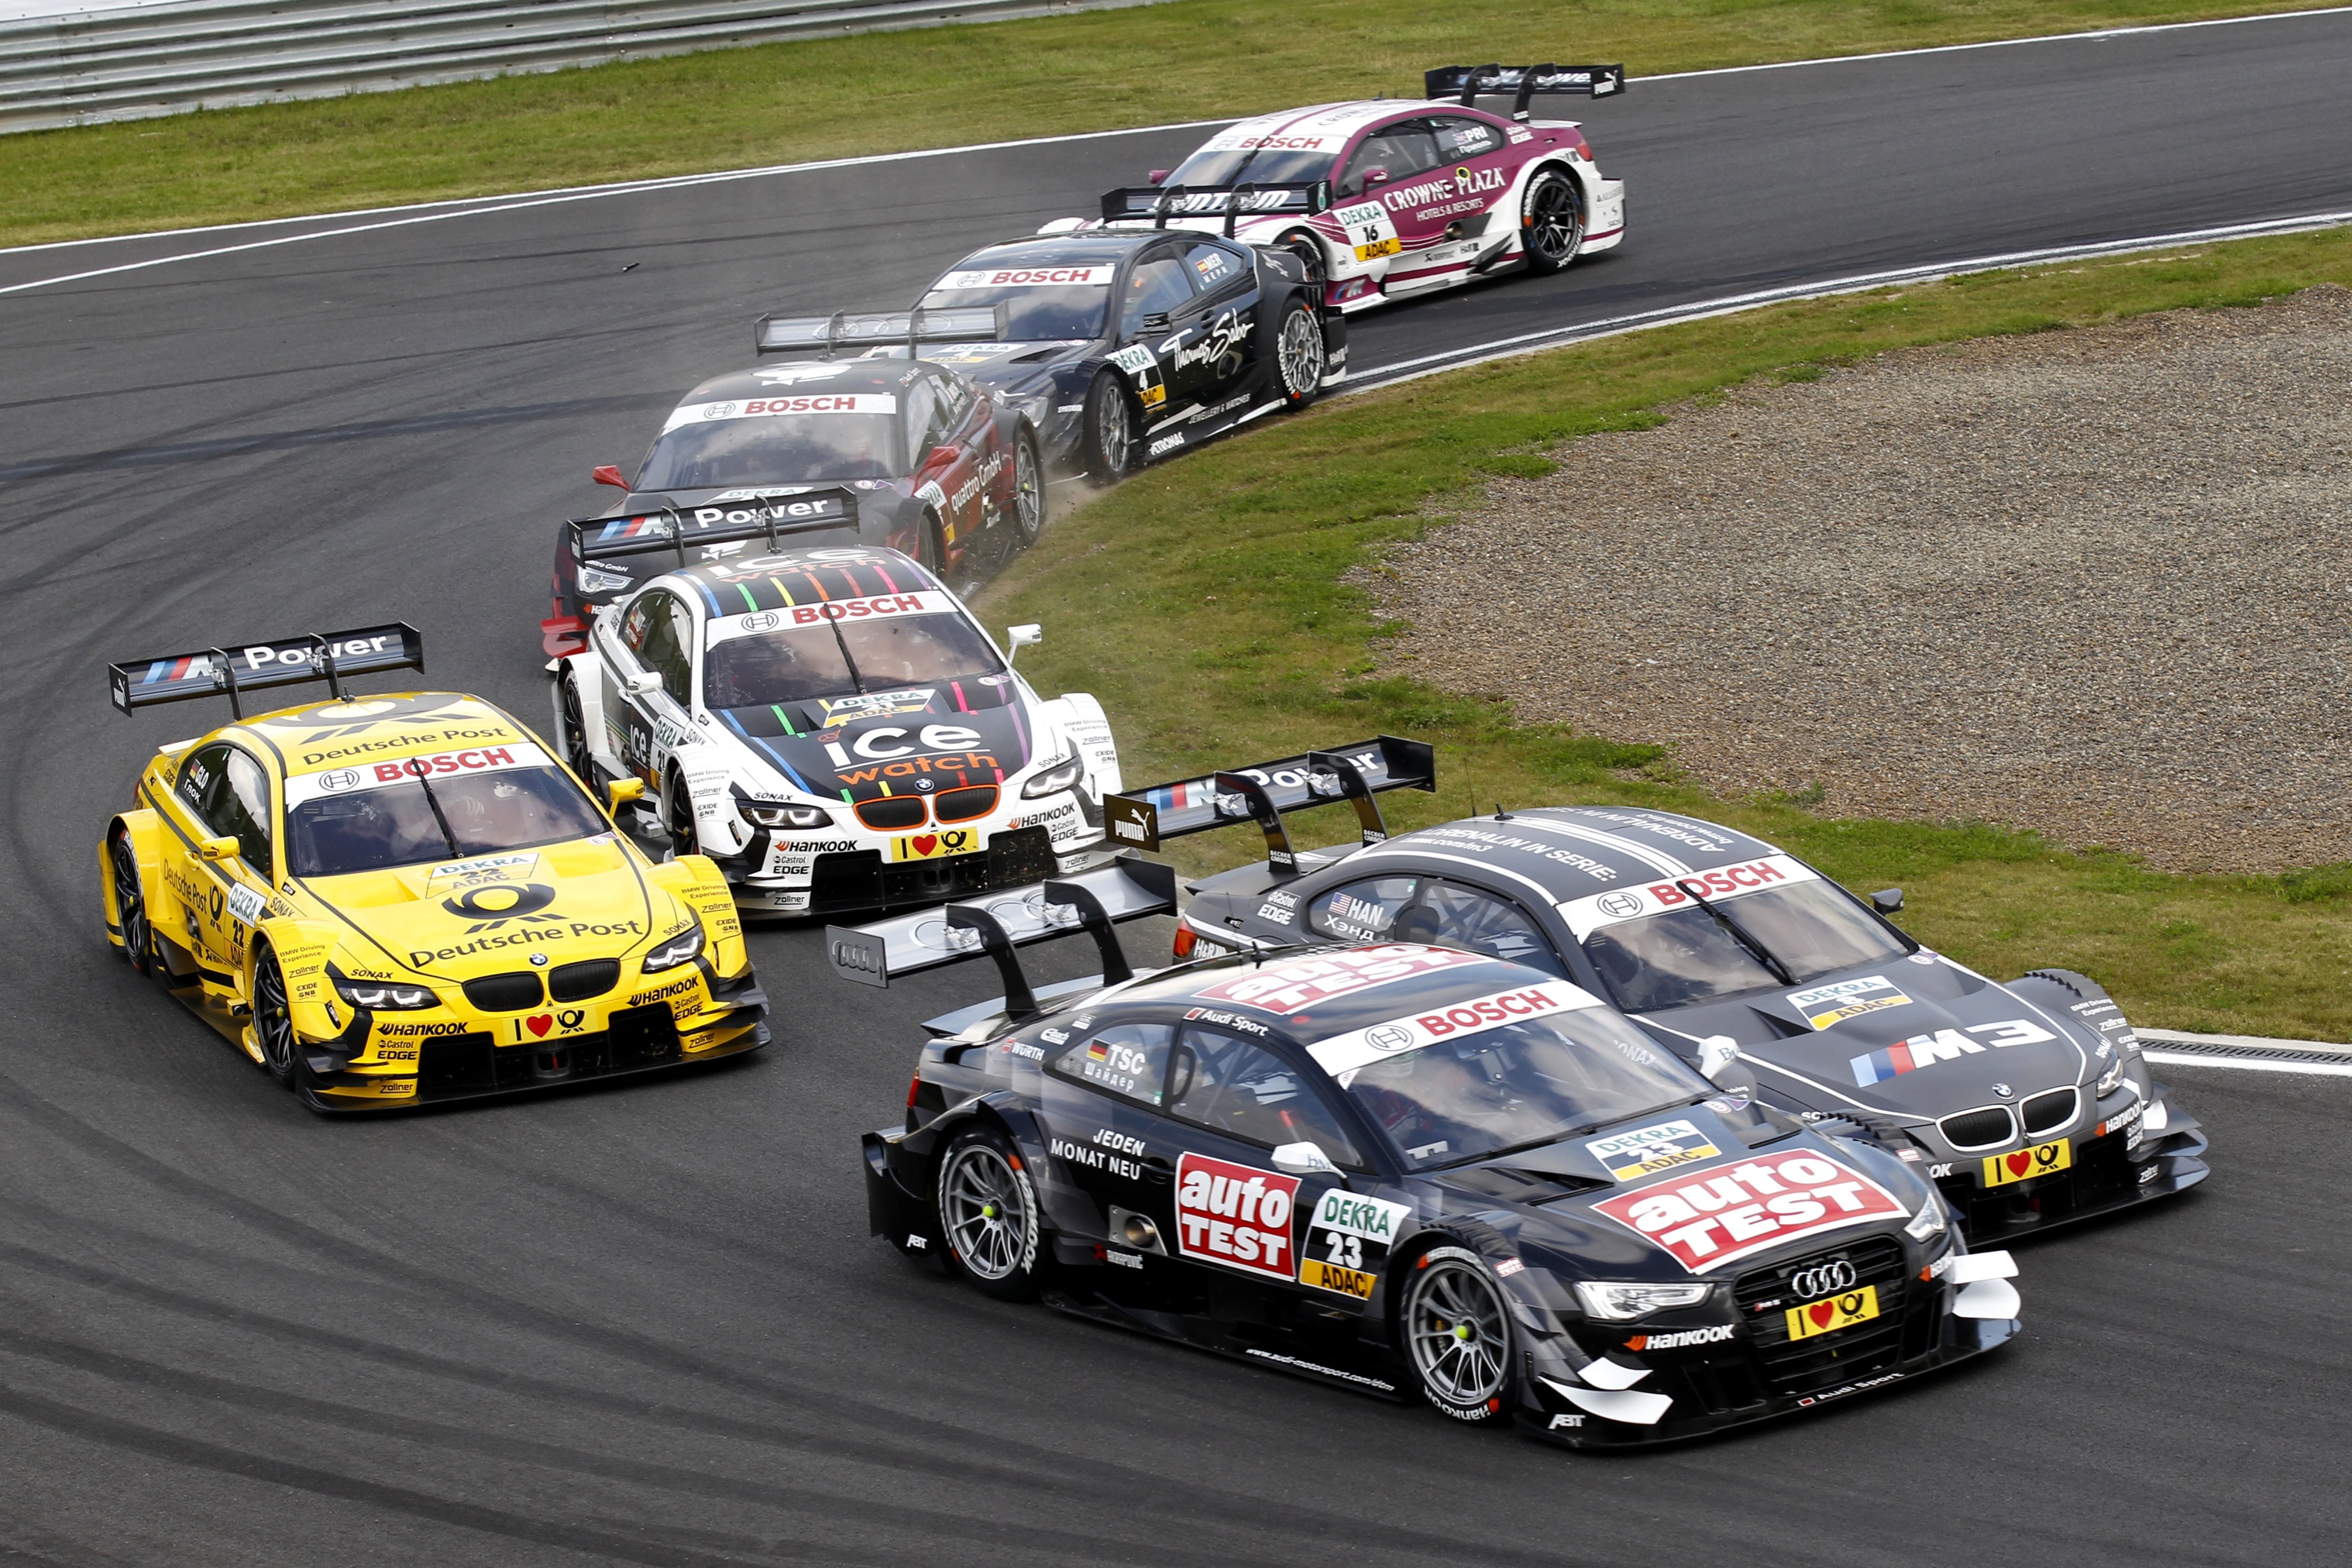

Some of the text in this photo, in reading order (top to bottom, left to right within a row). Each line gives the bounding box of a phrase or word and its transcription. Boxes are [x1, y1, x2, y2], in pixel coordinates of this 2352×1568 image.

[1239, 137, 1324, 149] BOSCH
[1465, 126, 1488, 142] PRI
[1384, 179, 1453, 211] CROWNE
[1455, 167, 1505, 195] PLAZA
[1342, 205, 1382, 225] DEKRA
[1416, 207, 1446, 222] HOTELS
[1363, 225, 1378, 242] 16
[1366, 241, 1391, 260] ADAC
[1206, 253, 1224, 270] MER
[990, 270, 1092, 284] BOSCH
[1158, 328, 1211, 372] Thomas
[1209, 308, 1254, 363] Sabo
[1139, 370, 1148, 390] 4
[744, 397, 856, 414] BOSCH
[1149, 432, 1185, 456] PETRONAS
[728, 488, 796, 497] DEKRA
[951, 476, 980, 514] quattro
[979, 451, 1002, 488] GmbH
[695, 500, 829, 528] Power
[606, 563, 629, 573] GmbH
[720, 556, 885, 583] watch
[792, 595, 924, 624] BOSCH
[244, 635, 387, 670] Power
[842, 692, 925, 707] DEKRA
[861, 701, 899, 711] 21
[848, 707, 904, 720] ADAC
[655, 721, 678, 748] DEKRA
[304, 727, 507, 765] Deutsche Post
[374, 748, 516, 782] BOSCH
[837, 753, 998, 786] watch
[1038, 753, 1067, 768] SONAX
[196, 765, 209, 789] GLO
[688, 775, 725, 785] Experience
[706, 769, 730, 778] Driving
[697, 803, 717, 811] EXIDE
[754, 793, 793, 801] SONAX
[699, 810, 715, 818] GNB
[1057, 818, 1076, 830] Castrol
[1050, 827, 1078, 843] EDGE
[1115, 820, 1145, 841] PUMA
[1363, 830, 1385, 838] BECKER
[1605, 813, 1726, 852] ADRENALIN
[901, 838, 908, 859] I
[1270, 850, 1291, 859] BECKER
[441, 855, 531, 874] DEKRA
[781, 856, 806, 865] Castrol
[1271, 855, 1292, 865] CARBON
[1521, 841, 1550, 854] IN
[1546, 849, 1617, 882] SERIE:
[459, 868, 500, 879] 22
[774, 866, 810, 875] EDGE
[164, 858, 207, 914] Deutsche Post
[452, 874, 511, 889] ADAC
[701, 884, 727, 892] Driving
[1648, 861, 1786, 906] BOSCH
[230, 887, 258, 922] DEKRA
[690, 890, 729, 899] Experience
[1274, 891, 1296, 909] Castrol
[1257, 904, 1295, 926] EDGE
[1347, 899, 1384, 927] HAN
[233, 920, 243, 948] 22
[663, 919, 692, 936] SONAX
[1323, 914, 1374, 941] Хэнд
[280, 944, 325, 958] BMW Driving
[409, 920, 644, 968] Deutsche Post
[282, 951, 322, 964] Experience
[351, 968, 394, 979] SONAX
[1225, 944, 1428, 1000] auto
[1255, 952, 1464, 1005] TEST
[295, 982, 318, 992] EXIDE
[298, 990, 315, 999] GNB
[1796, 978, 1885, 1002] DEKRA
[680, 993, 700, 1007] Castrol
[1836, 999, 1894, 1019] ADAC
[1840, 995, 1865, 1005] 8
[2070, 998, 2113, 1012] BMW Driving
[674, 1002, 703, 1021] EDGE
[1416, 986, 1559, 1037] BOSCH
[2082, 1005, 2117, 1017] Experience
[514, 1019, 521, 1041] I
[1201, 1009, 1269, 1037] Audi Sport
[387, 1040, 414, 1049] Castrol
[377, 1051, 418, 1060] EDGE
[1108, 1044, 1146, 1075] TSC
[1085, 1062, 1134, 1092] Шайдер
[1093, 1129, 1146, 1157] JEDEN
[1597, 1126, 1691, 1153] DEKRA
[1050, 1138, 1141, 1181] MONAT NEU
[1627, 1142, 1685, 1163] 23
[1640, 1150, 1702, 1172] ADAC
[1995, 1157, 2002, 1182] I
[1180, 1170, 1290, 1229] auto
[1628, 1157, 1838, 1233] auto
[1324, 1196, 1389, 1236] DEKRA
[1660, 1181, 1865, 1257] TEST
[906, 1234, 927, 1249] ABT
[1181, 1212, 1288, 1267] TEST
[1326, 1232, 1363, 1269] 23
[1322, 1264, 1366, 1297] ADAC
[1798, 1309, 1806, 1336] I
[1817, 1372, 1905, 1400] Audi Sport
[1548, 1414, 1586, 1429] ABT
